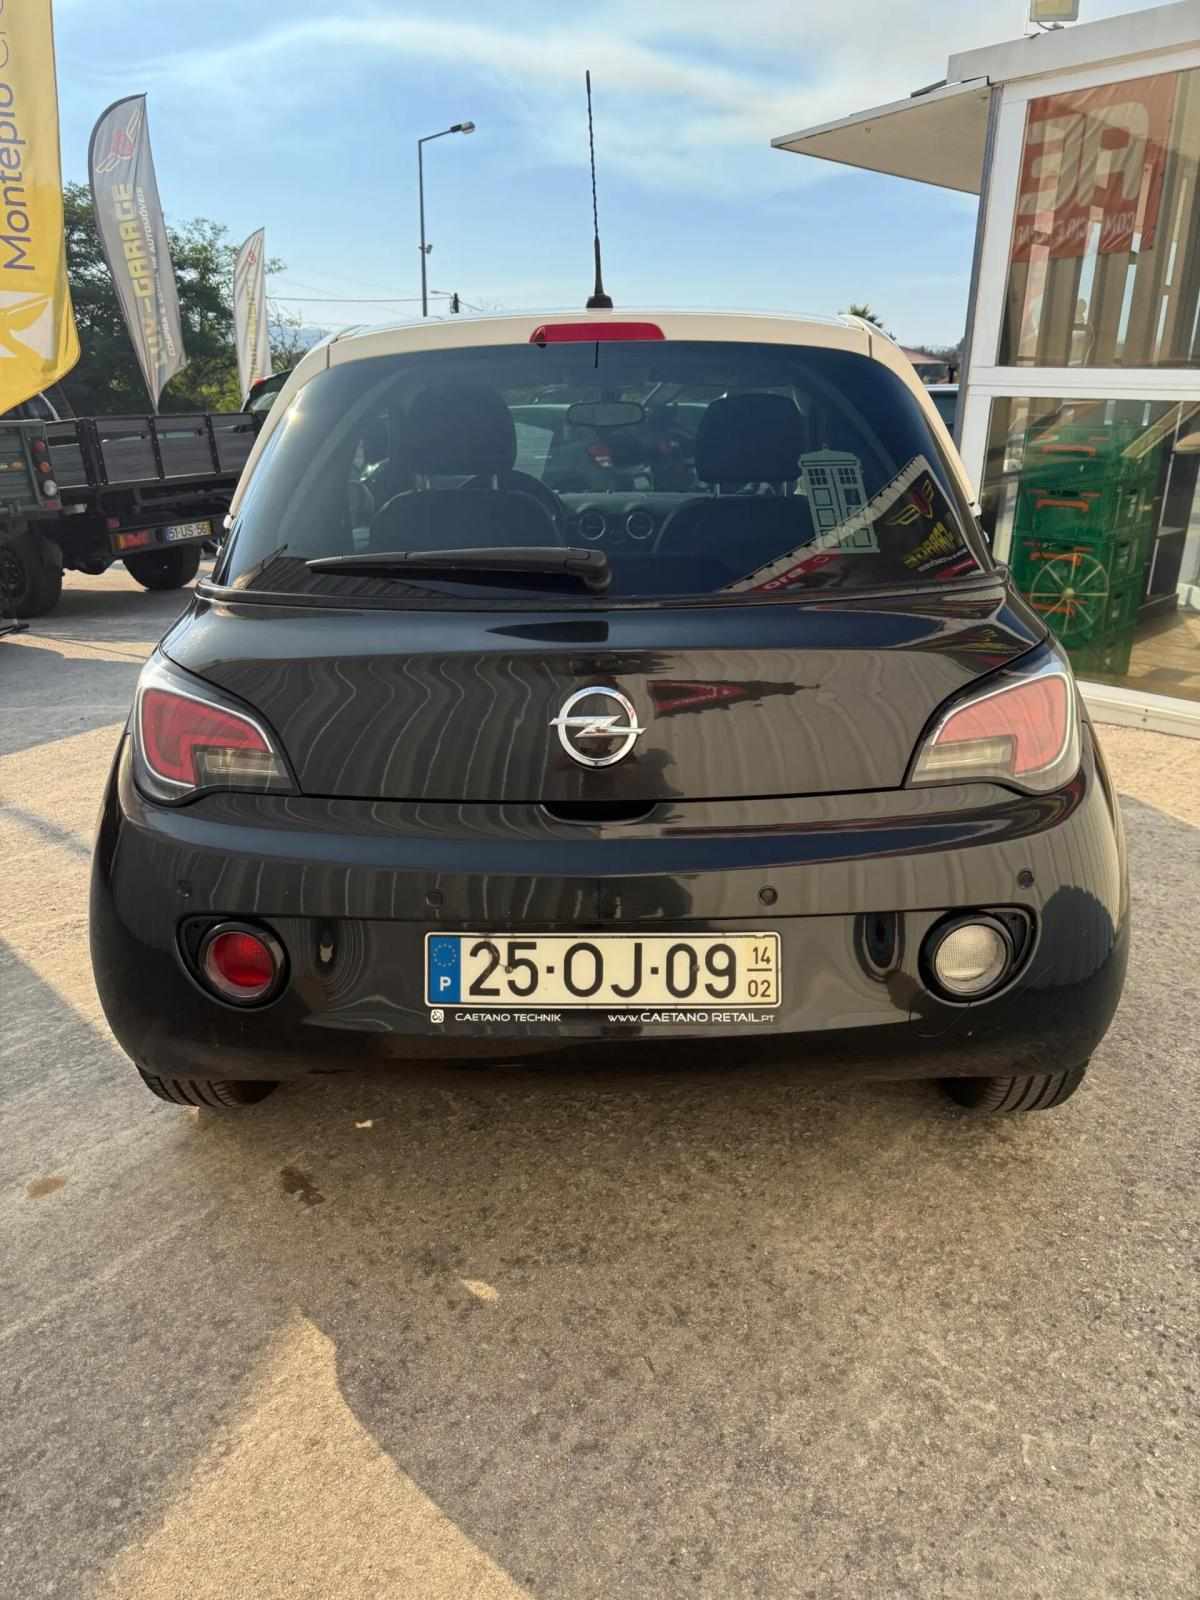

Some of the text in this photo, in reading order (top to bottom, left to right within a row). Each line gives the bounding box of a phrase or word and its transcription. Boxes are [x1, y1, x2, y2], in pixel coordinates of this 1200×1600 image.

[752, 947, 771, 965] 14
[439, 976, 451, 992] P
[747, 980, 771, 998] 02
[454, 1013, 561, 1022] CAETANO TECHNIK
